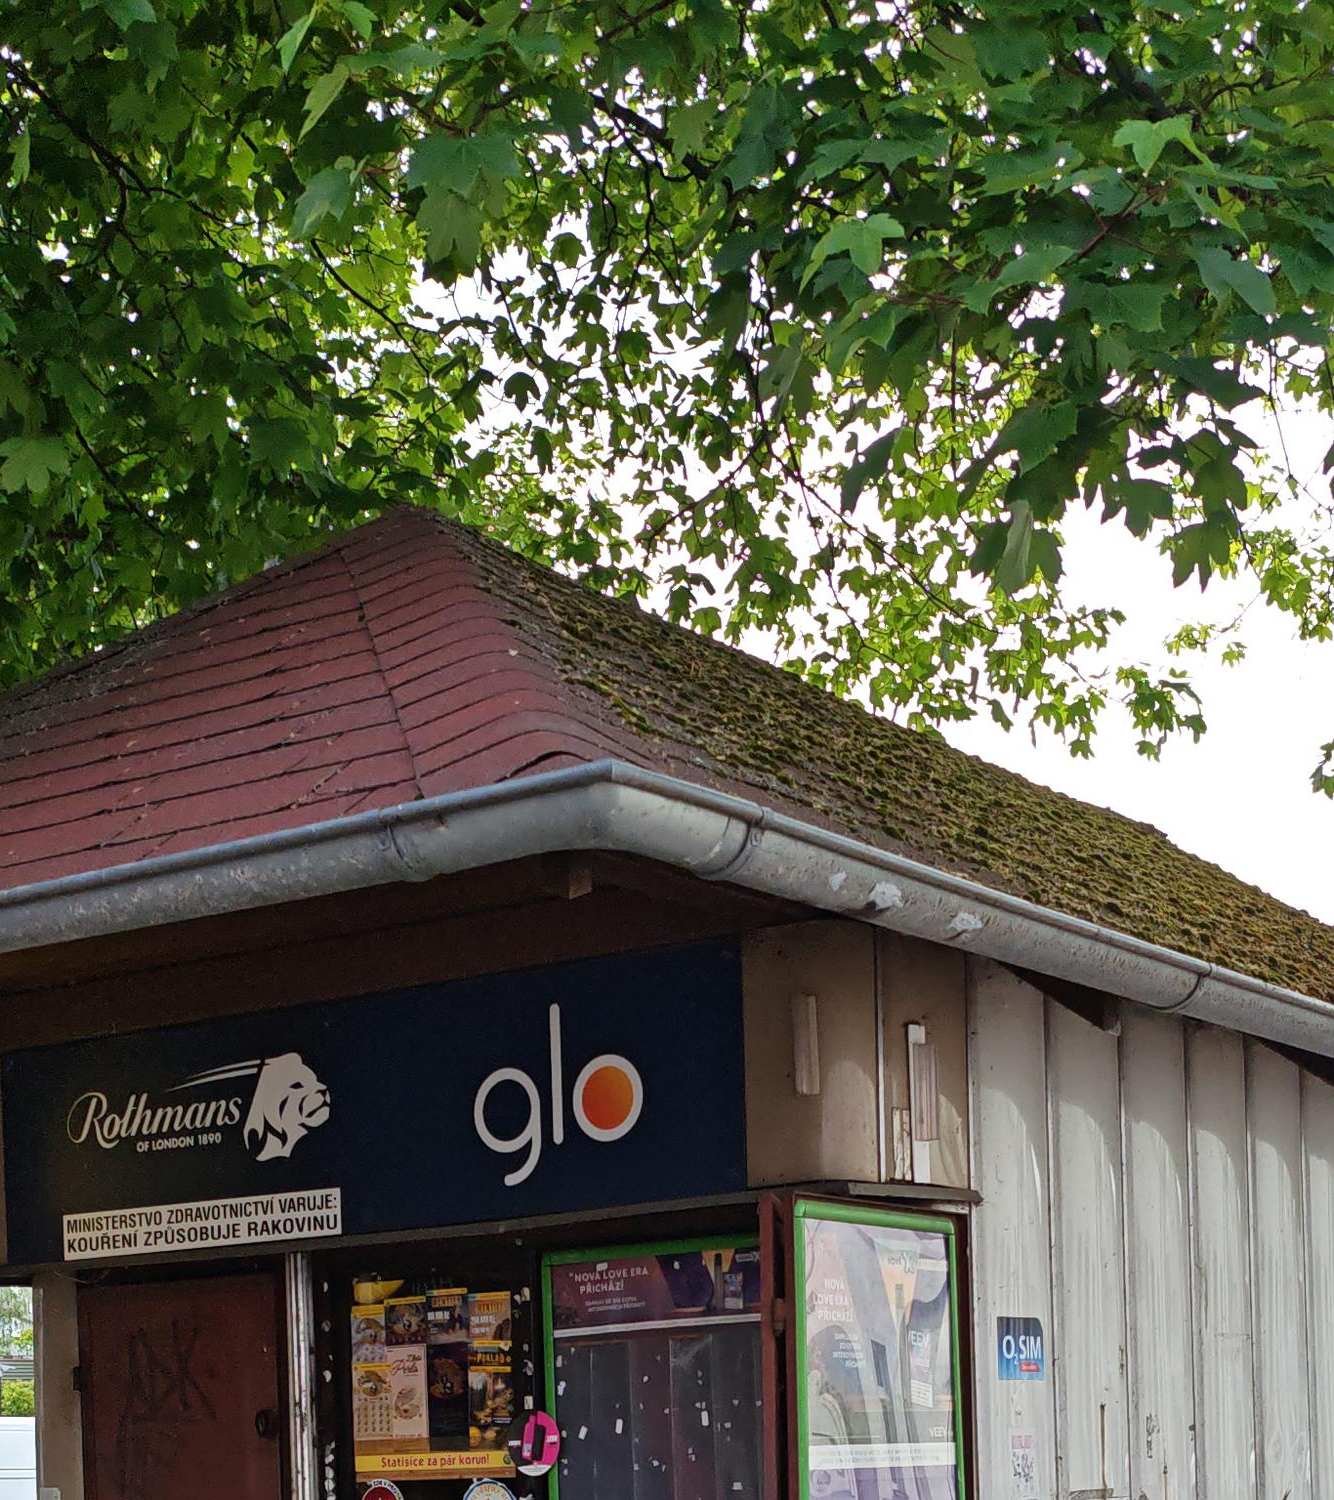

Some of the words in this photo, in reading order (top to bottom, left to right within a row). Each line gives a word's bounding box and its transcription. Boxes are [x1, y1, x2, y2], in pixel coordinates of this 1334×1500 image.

[473, 1003, 644, 1187] glo
[67, 1092, 243, 1154] Rothmans
[136, 1141, 150, 1153] OF
[151, 1136, 194, 1152] LONDON
[198, 1133, 222, 1147] 1890
[66, 1210, 162, 1235] MINISTERSTVO
[166, 1196, 274, 1225] ZDRAVOTNICTVÍ
[280, 1193, 337, 1213] VARUJE:
[67, 1229, 138, 1254] KOUŘENÍ
[144, 1220, 241, 1247] ZPŮSOBUJE
[247, 1214, 338, 1238] RAKOVINU
[603, 1269, 627, 1281] LOVE
[630, 1266, 649, 1278] ERA
[1018, 1334, 1042, 1360] SIM
[381, 1456, 424, 1468] Statisíce
[427, 1457, 438, 1467] za
[440, 1456, 456, 1469] pár
[458, 1453, 490, 1466] korun!
